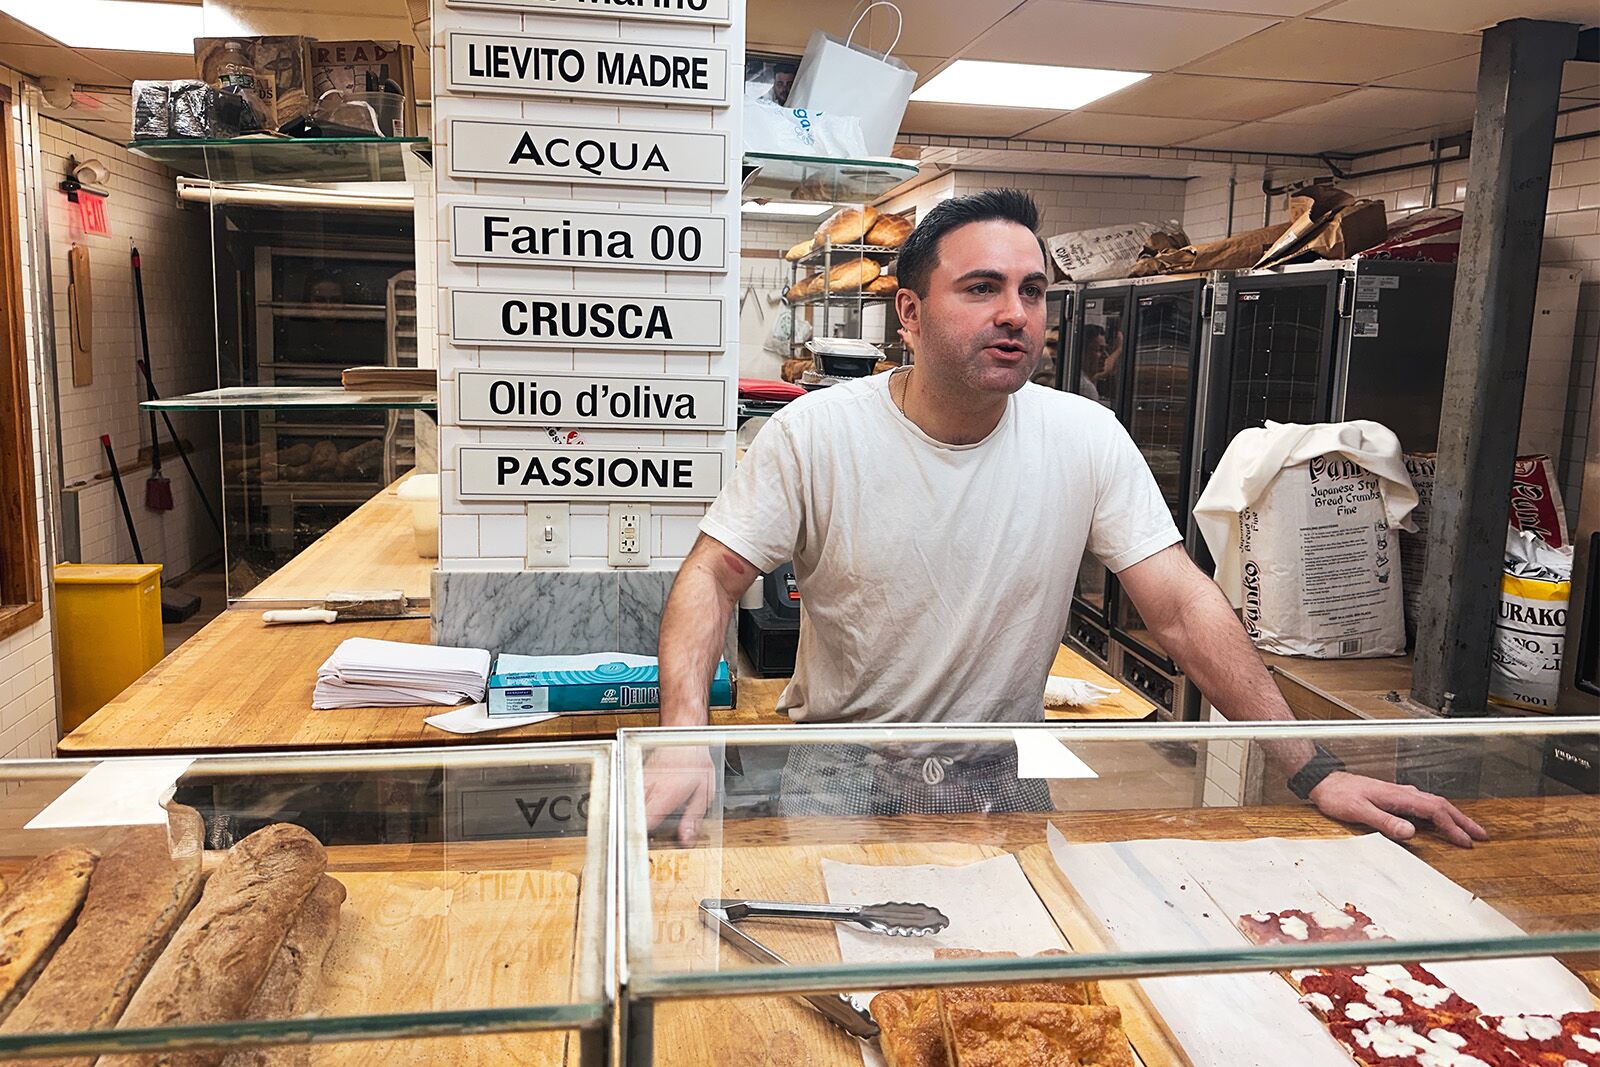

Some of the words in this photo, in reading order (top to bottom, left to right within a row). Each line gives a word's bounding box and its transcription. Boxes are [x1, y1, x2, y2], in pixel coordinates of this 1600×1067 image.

[468, 43, 585, 83] LIEVITO
[597, 51, 708, 90] MADRE
[508, 130, 670, 176] ACQUA
[85, 196, 107, 233] EXIT
[483, 215, 634, 259] Farina
[651, 225, 702, 262] 00
[501, 300, 673, 340] CRUSCA
[489, 380, 562, 416] Olio
[496, 456, 694, 489] PASSIONE
[1310, 484, 1355, 498] Japanese
[1314, 496, 1343, 508] Bread
[1345, 489, 1381, 504] Crumbs
[1336, 504, 1358, 517] Fine
[1498, 600, 1567, 627] URAKO
[1513, 692, 1548, 706] 7001
